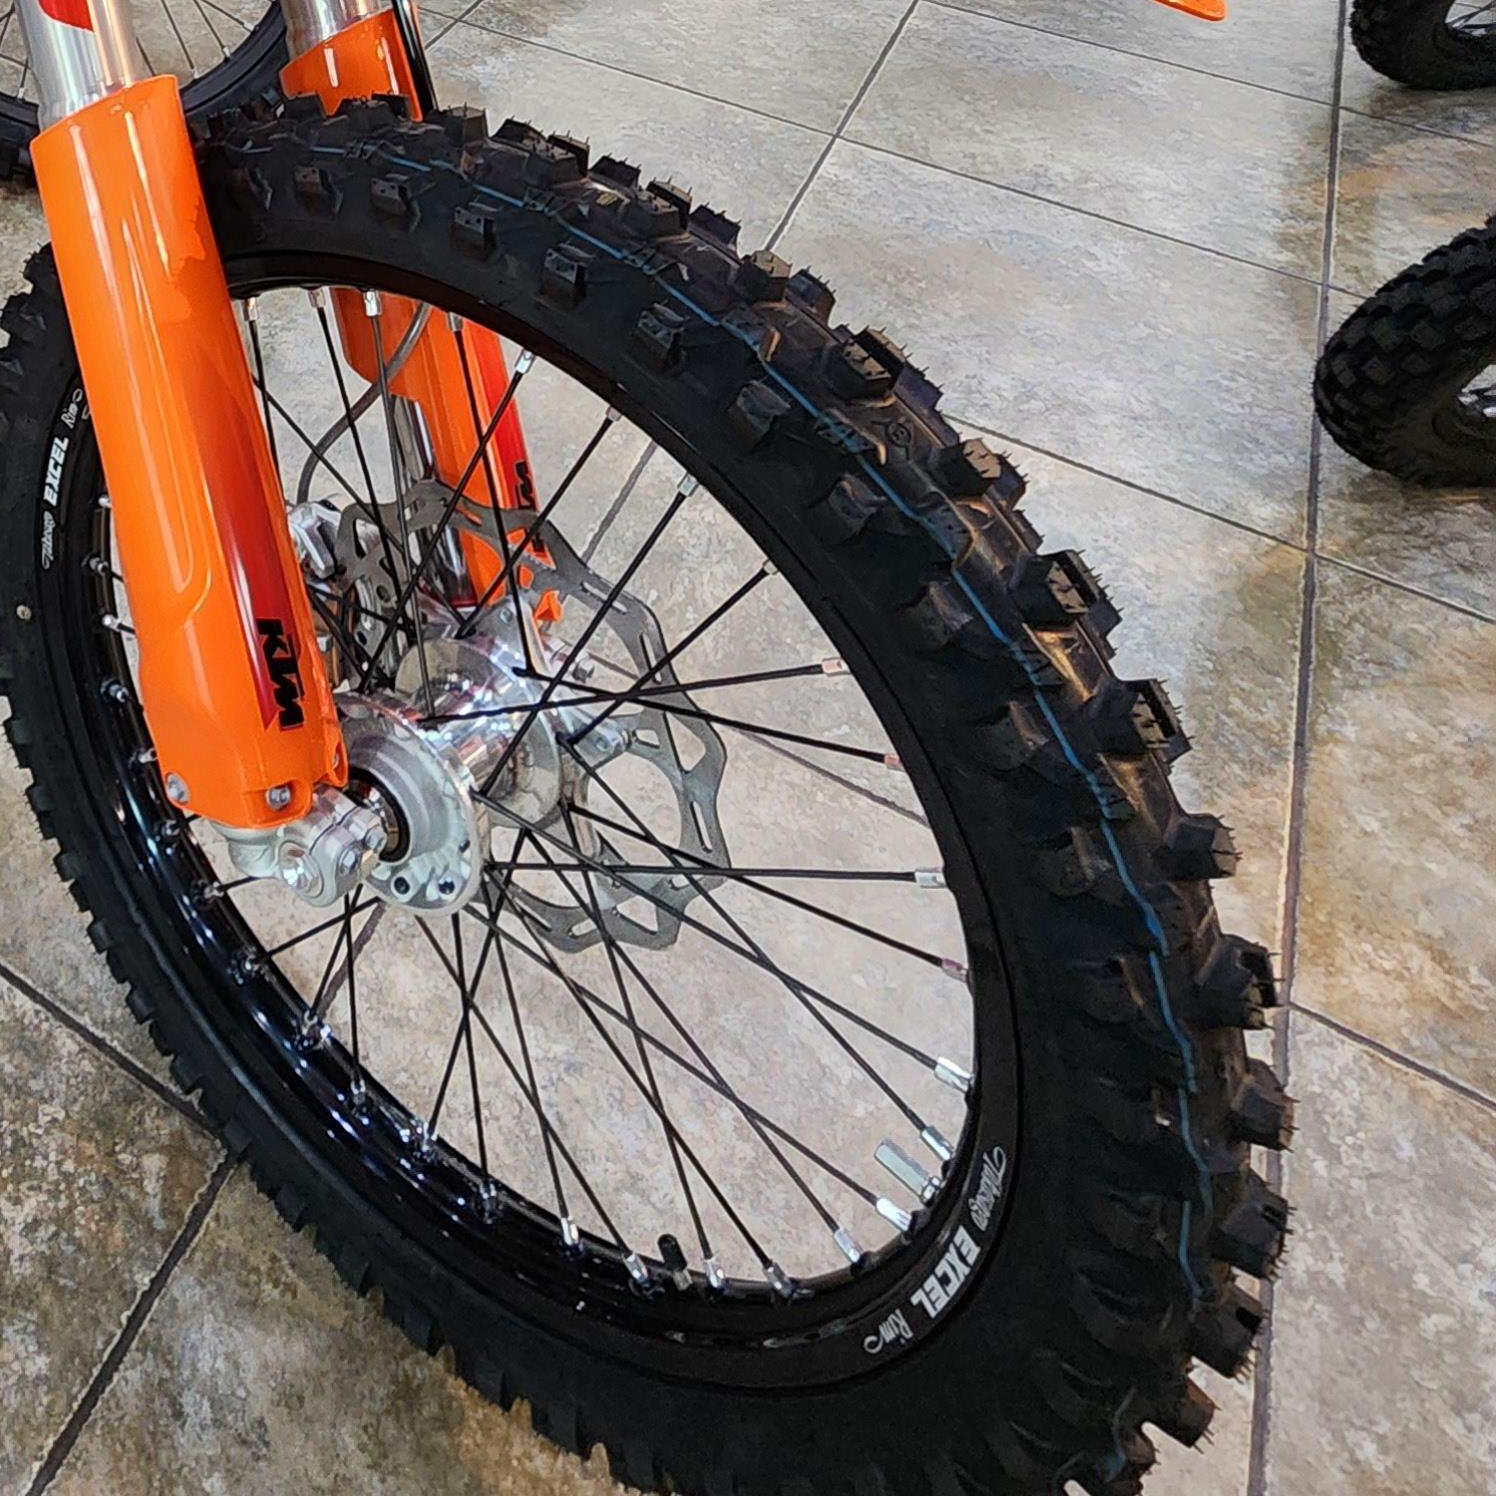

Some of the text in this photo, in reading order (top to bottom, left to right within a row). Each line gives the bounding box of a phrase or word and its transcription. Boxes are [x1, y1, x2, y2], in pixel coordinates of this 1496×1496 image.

[43, 436, 70, 507] EXCEL
[60, 388, 83, 430] Rim
[255, 618, 306, 728] KTM
[909, 1224, 982, 1319] EXCEL
[863, 1308, 915, 1355] Rim
